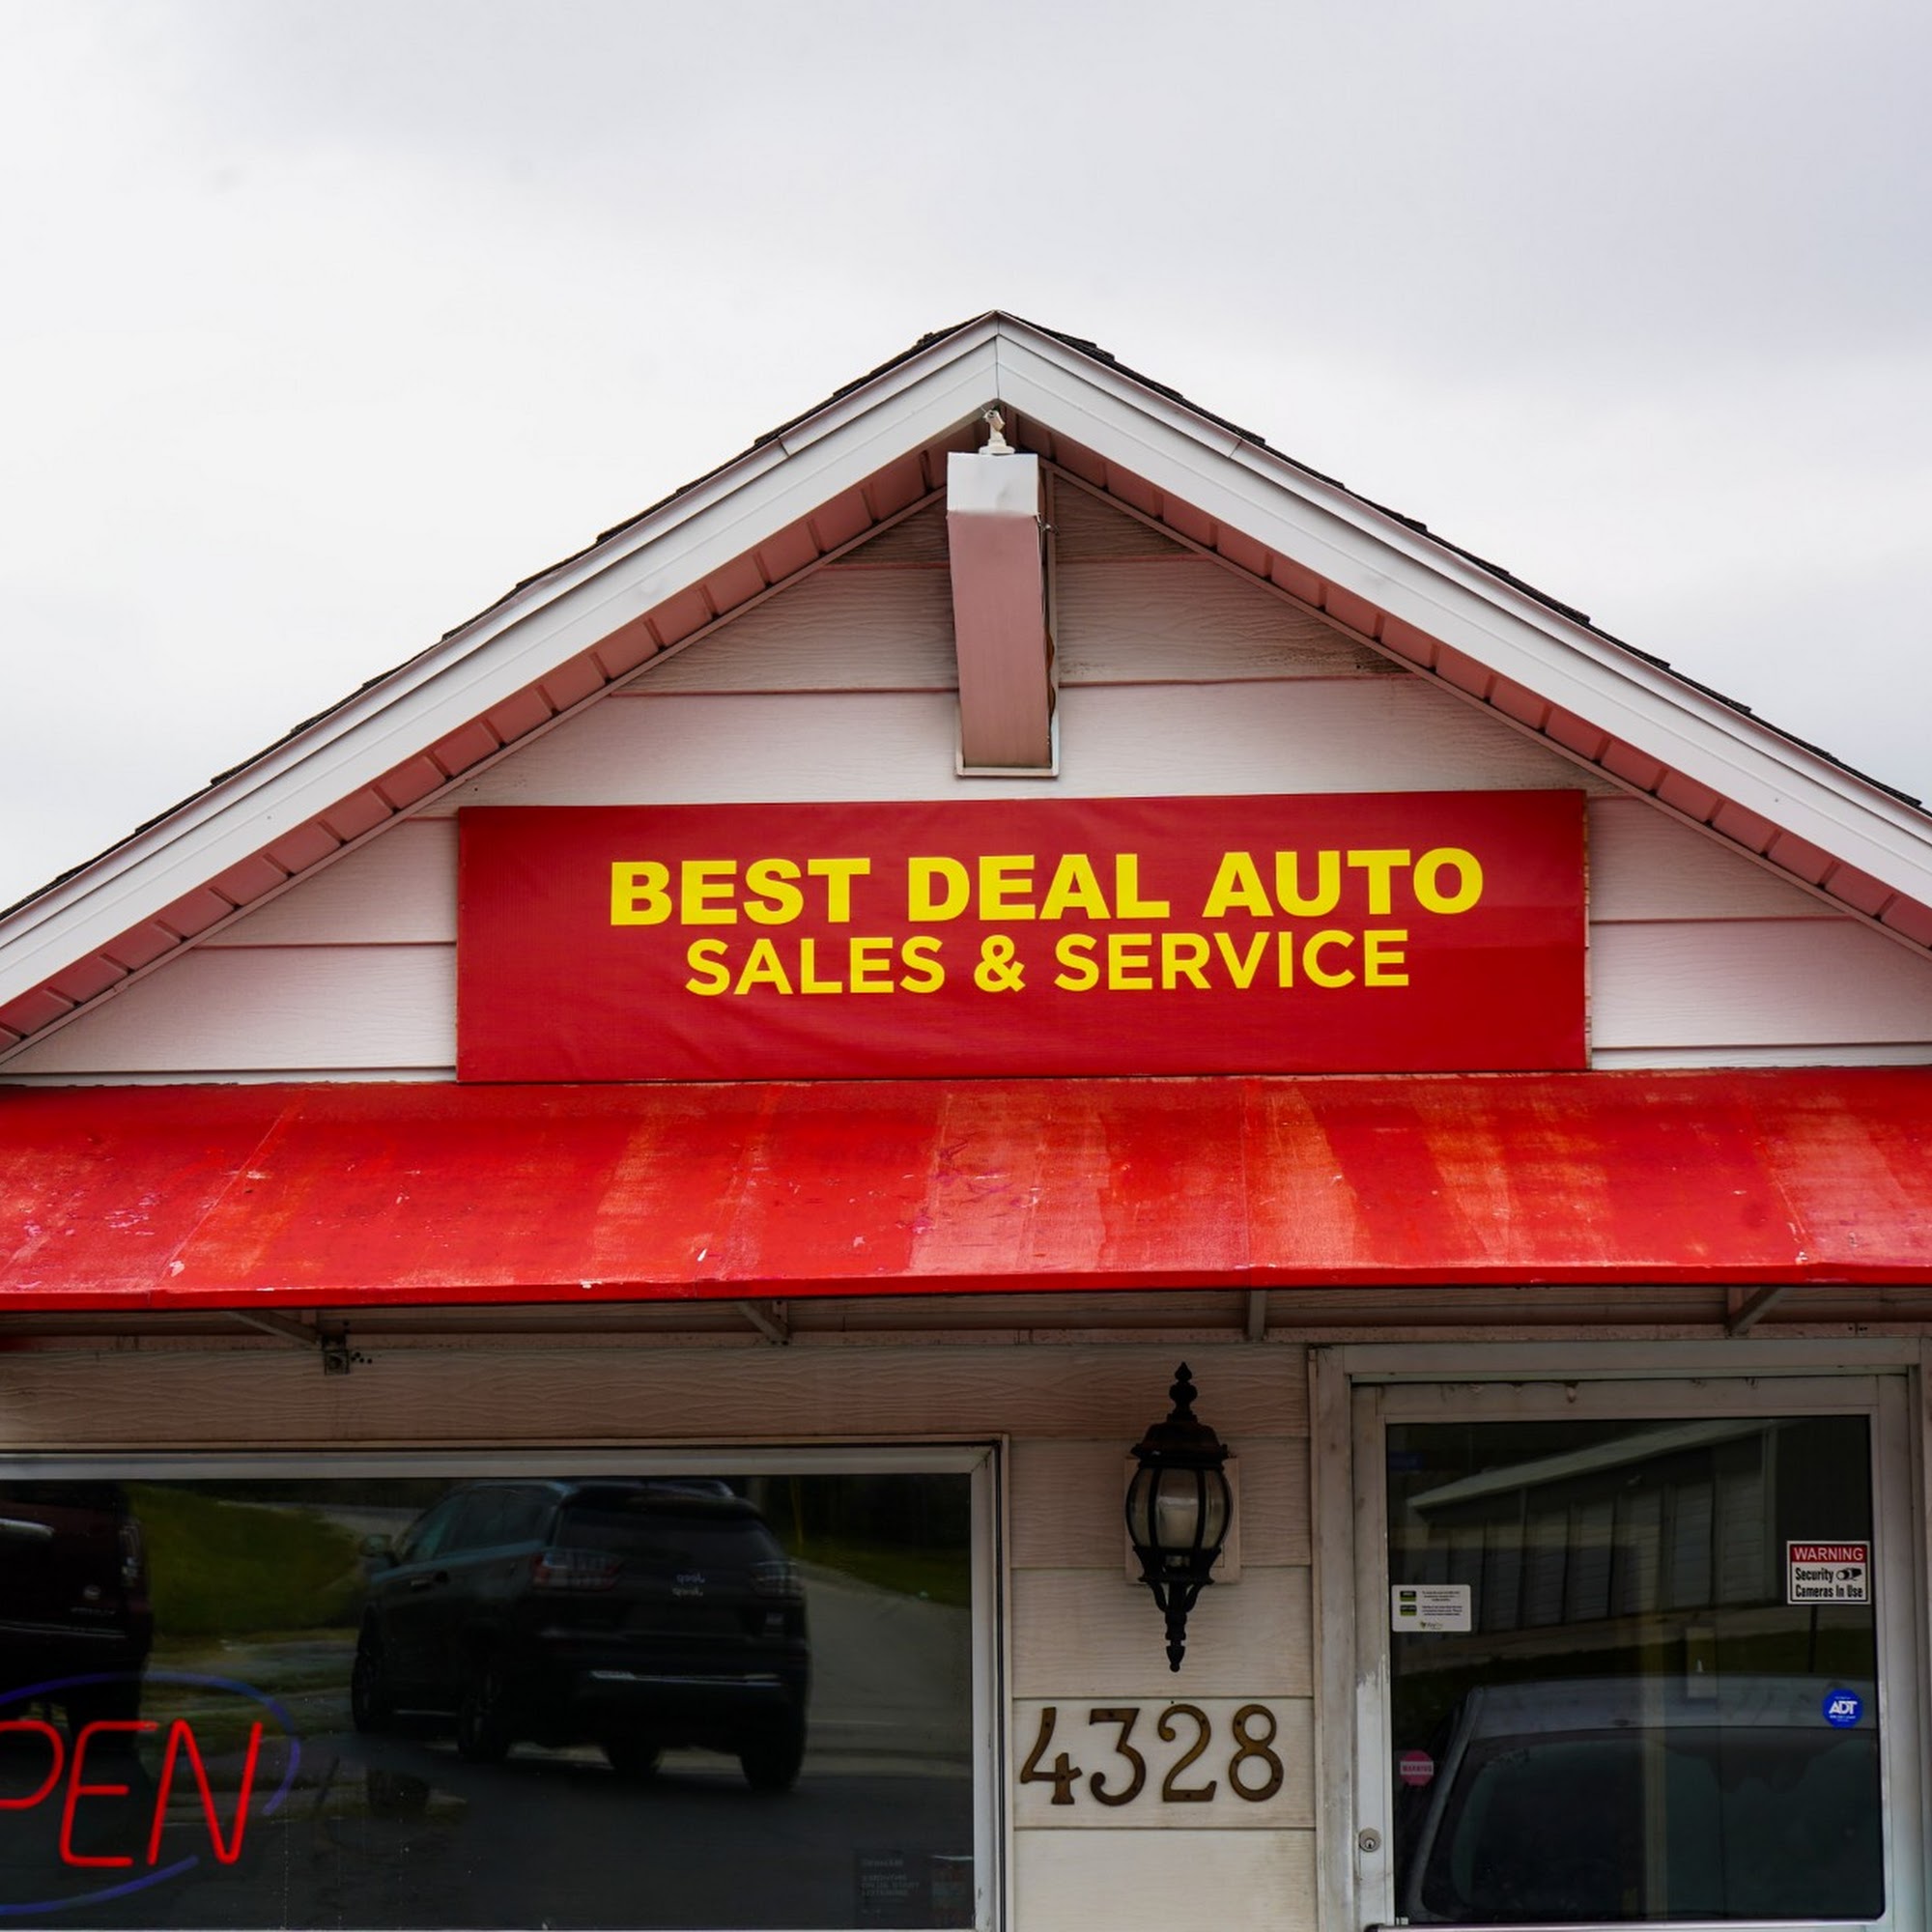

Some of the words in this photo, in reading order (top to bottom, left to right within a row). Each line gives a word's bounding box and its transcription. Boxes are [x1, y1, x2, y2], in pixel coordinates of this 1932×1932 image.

[611, 858, 870, 925] BEST
[908, 853, 1170, 922] DEAL
[1202, 847, 1484, 918] AUTO
[685, 934, 946, 996] SALES
[974, 934, 1026, 992] &
[1054, 929, 1409, 991] SERVICE
[1793, 1548, 1864, 1561] WARNING
[1795, 1567, 1834, 1583] Security
[1795, 1584, 1834, 1598] Cameras
[1846, 1584, 1863, 1598] Use
[1829, 1700, 1858, 1715] ADT
[1020, 1704, 1284, 1806] 4328
